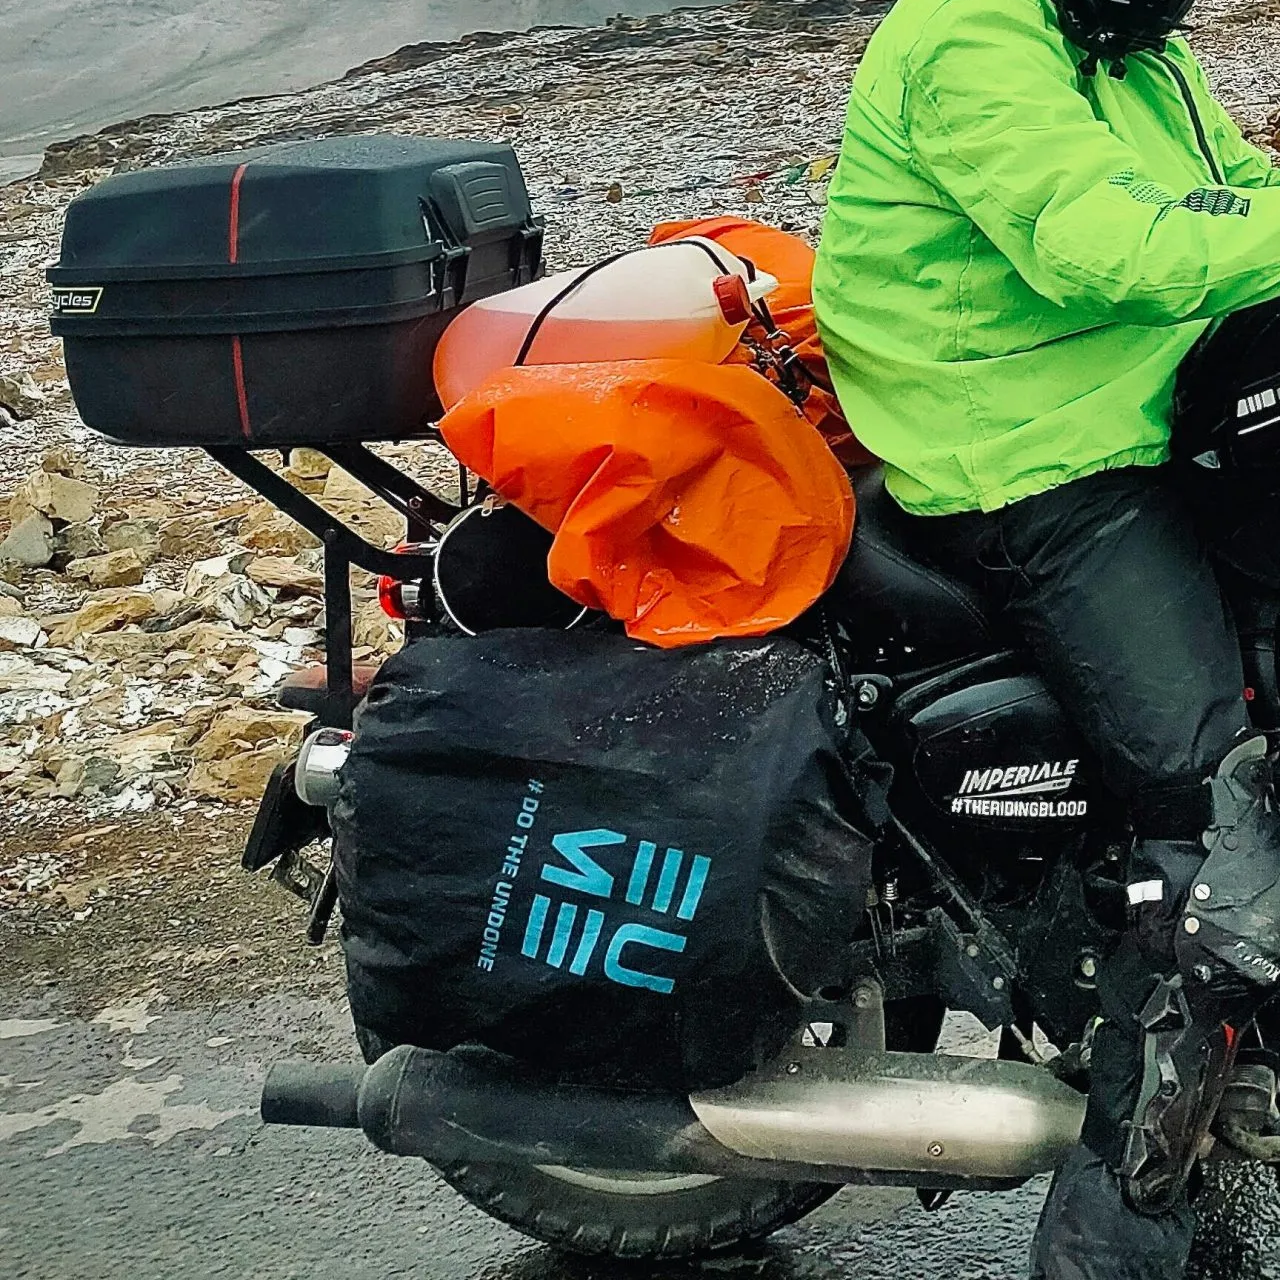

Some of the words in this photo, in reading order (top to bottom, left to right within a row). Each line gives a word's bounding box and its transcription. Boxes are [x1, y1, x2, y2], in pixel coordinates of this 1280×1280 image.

[51, 291, 93, 309] ycles
[958, 759, 1080, 794] IMPERIALE
[951, 798, 1087, 817] #THERIDINGBLOOD
[502, 834, 529, 879] THE
[477, 881, 514, 972] UNDONE
